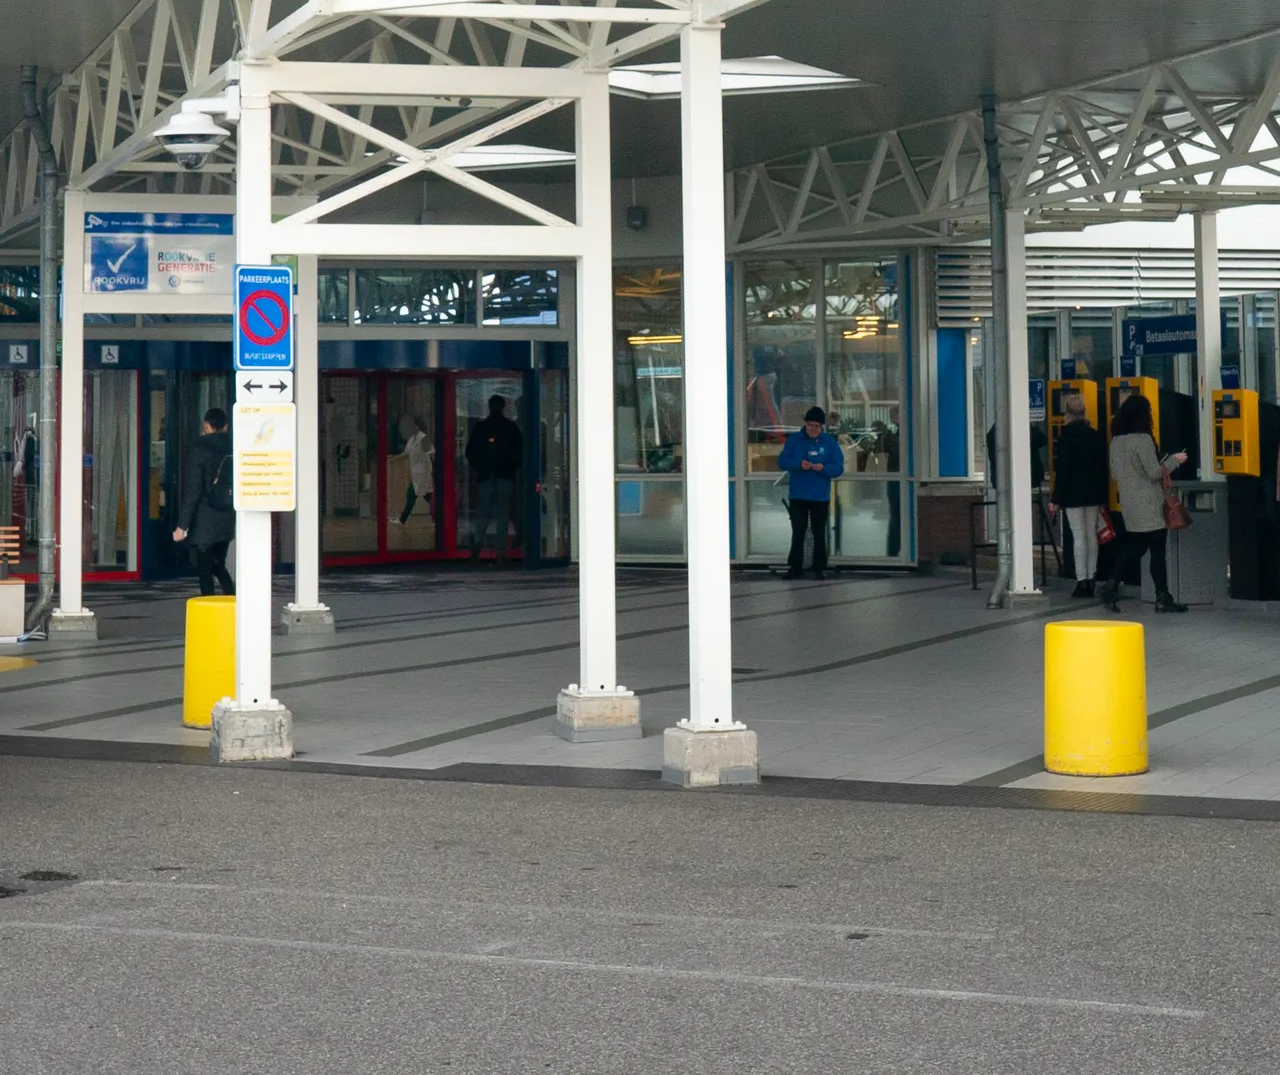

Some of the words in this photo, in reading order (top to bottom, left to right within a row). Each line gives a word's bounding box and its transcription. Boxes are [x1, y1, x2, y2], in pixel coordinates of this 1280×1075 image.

[94, 276, 145, 286] ROOKVRIJ
[239, 274, 290, 284] PARKEERPLAATS
[1145, 329, 1197, 343] Betaalautomaa
